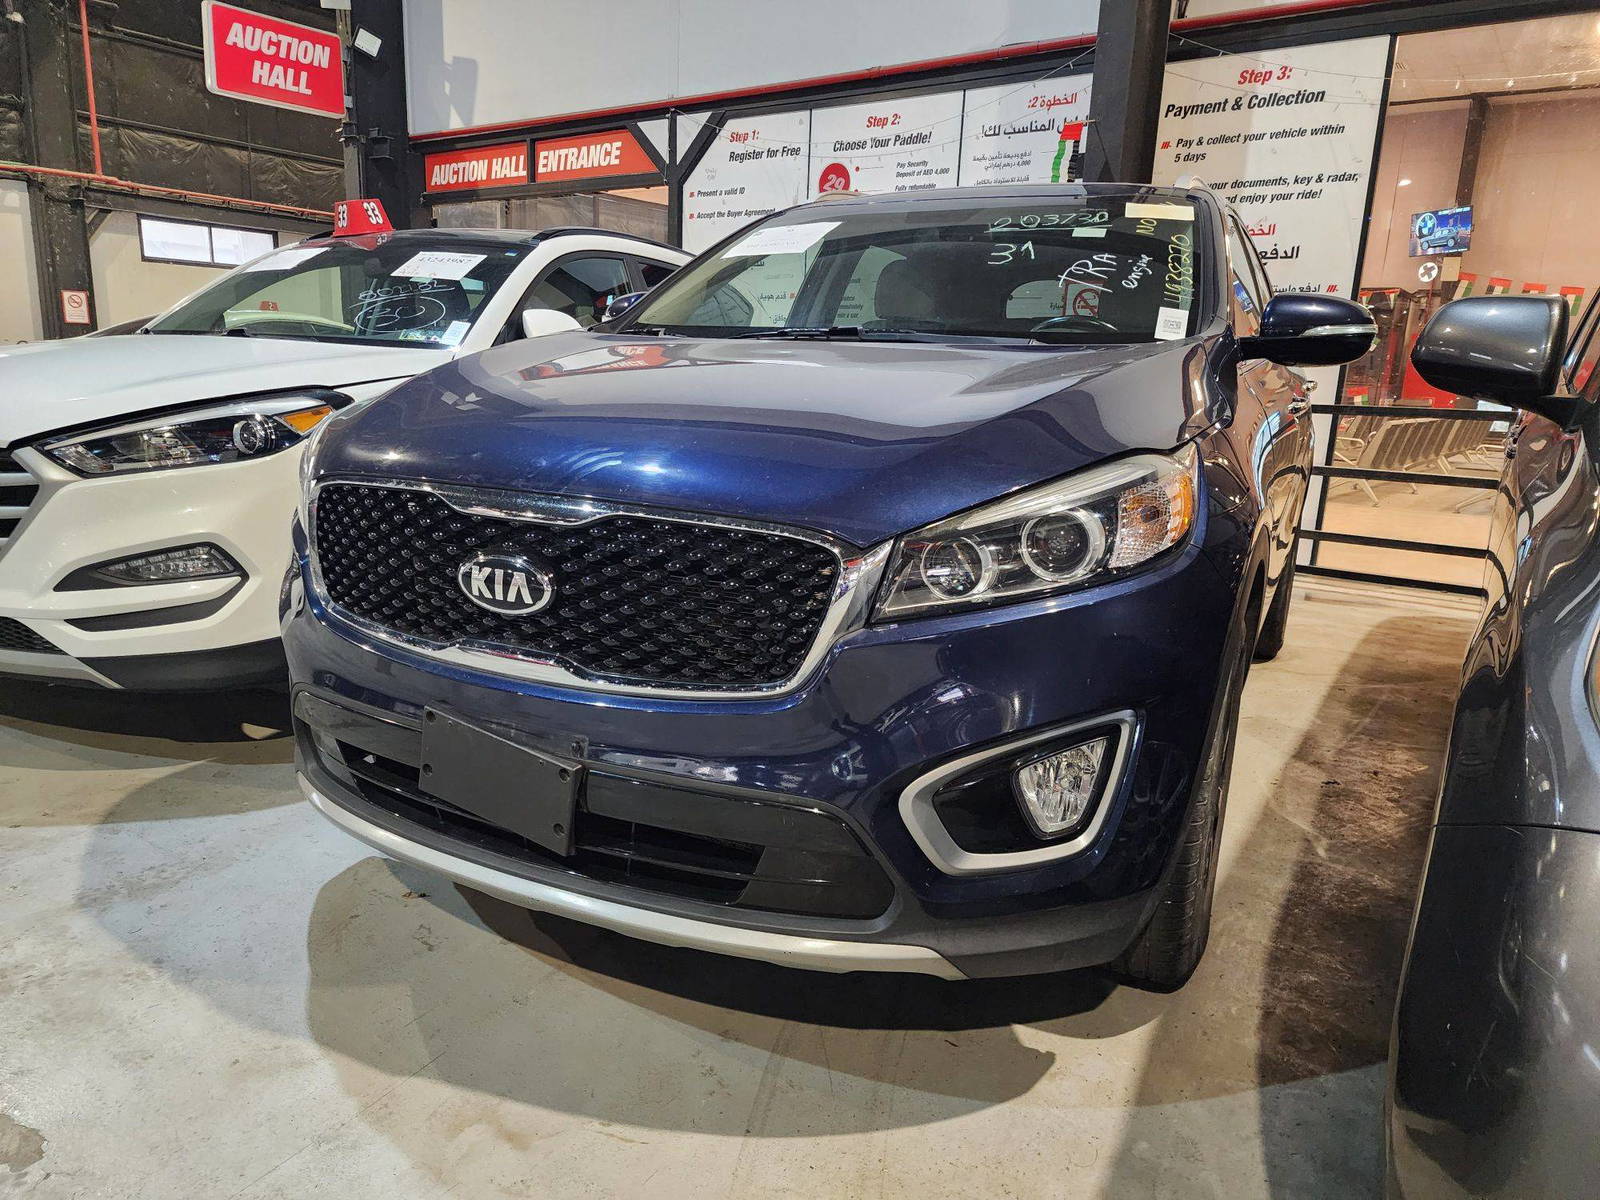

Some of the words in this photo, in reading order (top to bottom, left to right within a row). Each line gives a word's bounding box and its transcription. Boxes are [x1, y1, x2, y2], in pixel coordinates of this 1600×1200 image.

[225, 22, 330, 69] AUCTION
[252, 60, 312, 96] HALL
[1238, 67, 1273, 86] Step
[1277, 65, 1293, 80] 3:
[1039, 92, 1078, 111] الخطوة
[1164, 98, 1227, 119] Payment
[1231, 96, 1244, 111] &
[1247, 88, 1326, 109] Collection
[866, 115, 888, 129] Step
[891, 113, 901, 126] 2:
[1003, 118, 1055, 140] المناسب
[729, 131, 749, 143] Step
[752, 129, 760, 141] 1:
[833, 138, 868, 153] Choose
[870, 136, 892, 149] Your
[893, 131, 933, 146] Paddle!
[1176, 137, 1194, 150] Pay
[1196, 136, 1204, 147] &
[1206, 133, 1241, 146] collect
[1243, 132, 1266, 145] your
[1270, 128, 1307, 140] vehicle
[1310, 123, 1345, 136] within
[538, 141, 622, 174] ENTRANCE
[729, 149, 764, 163] Register
[766, 147, 780, 159] for
[781, 145, 801, 158] Free
[896, 161, 906, 169] Pay
[907, 160, 928, 168] Security
[1174, 153, 1181, 163] 5
[1183, 151, 1207, 163] days
[431, 159, 488, 186] AUCTION
[491, 155, 527, 179] HALL
[896, 171, 916, 179] Deposit
[1230, 176, 1290, 190] documents,
[1293, 174, 1314, 187] key
[1315, 173, 1324, 183] &
[1327, 172, 1359, 184] radar,
[697, 189, 718, 198] Present
[724, 187, 738, 196] valid
[739, 186, 746, 195] ID
[1240, 193, 1267, 205] enjoy
[1270, 192, 1294, 203] your
[1296, 189, 1323, 200] ride!
[337, 204, 348, 228] 33
[362, 201, 384, 225] 33
[697, 211, 716, 220] Accept
[717, 210, 725, 218] the
[726, 209, 744, 219] Buyer
[471, 565, 534, 605] KIA
